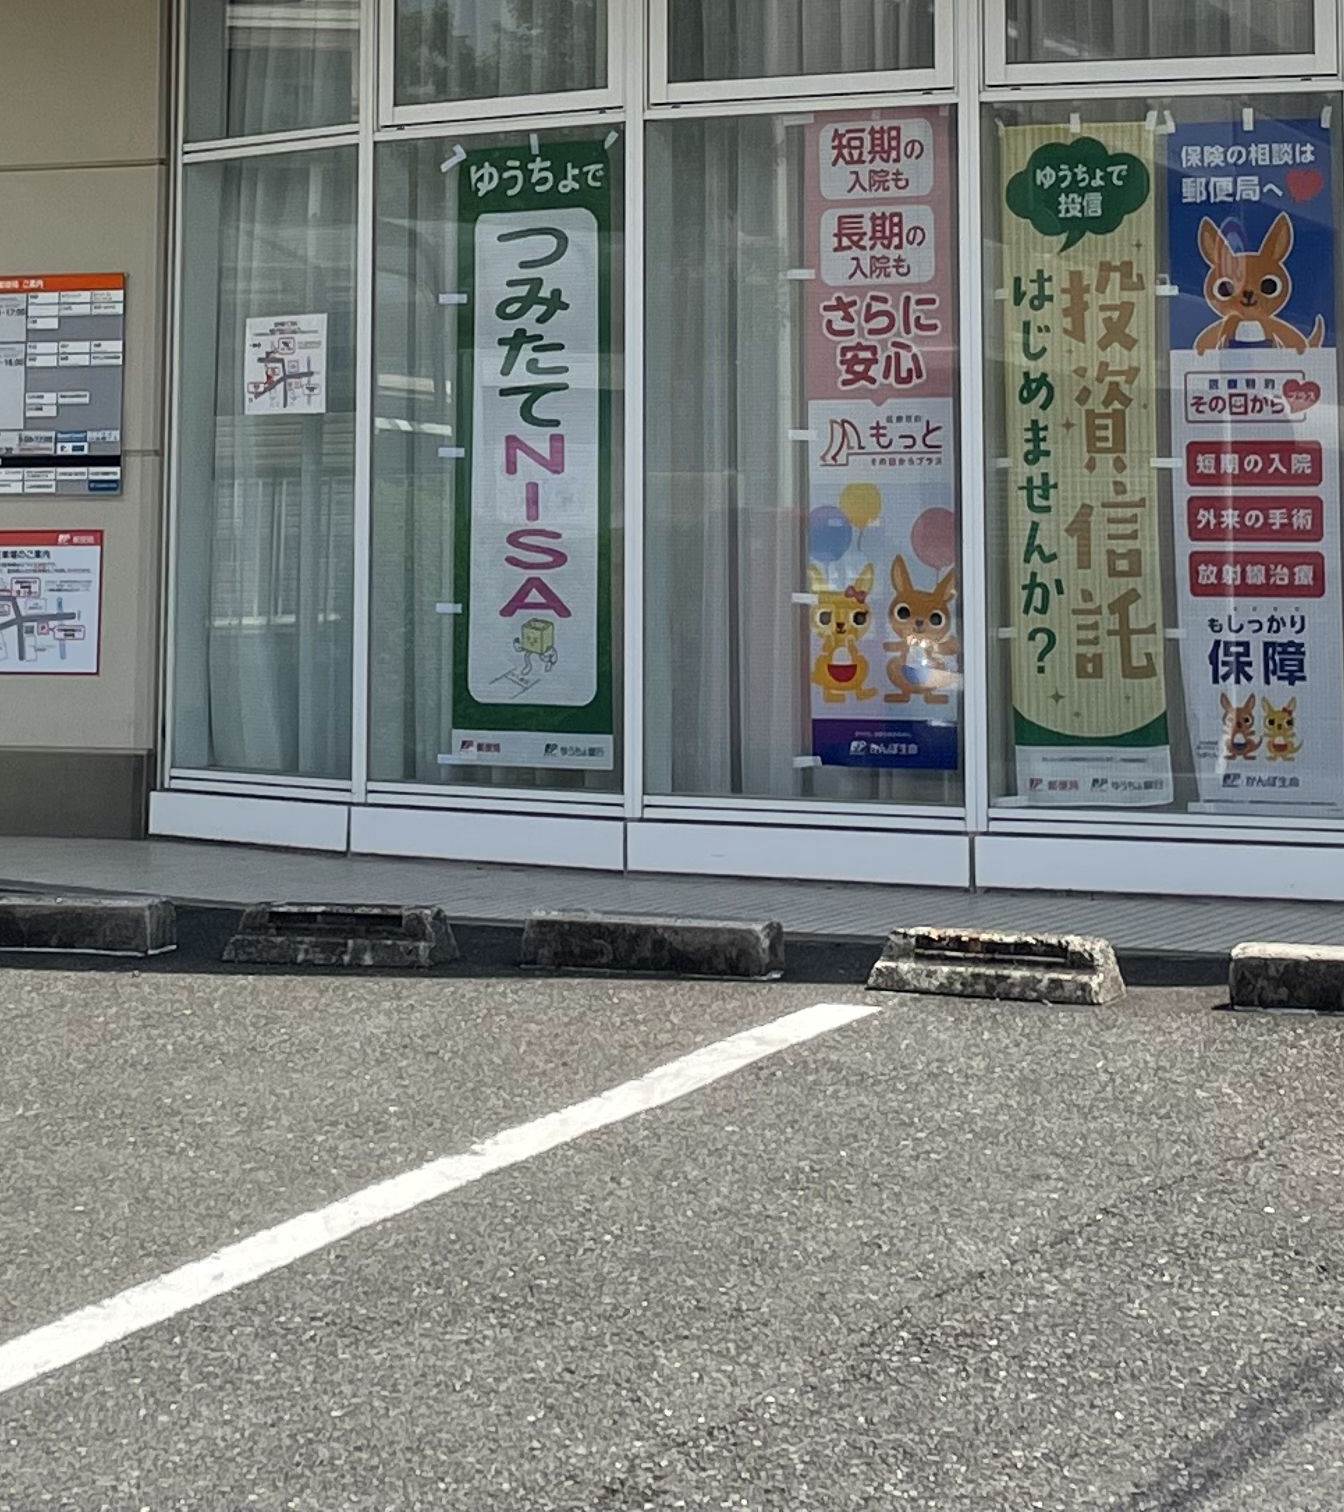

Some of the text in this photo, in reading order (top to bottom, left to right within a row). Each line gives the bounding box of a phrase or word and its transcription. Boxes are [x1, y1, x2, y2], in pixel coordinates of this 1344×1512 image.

[830, 125, 924, 167] 短期の
[1181, 142, 1316, 168] 保険の相談は
[469, 156, 605, 197] ゆうちょで
[846, 169, 910, 194] 入院も
[1035, 164, 1129, 190] ゆうちょで
[1181, 175, 1284, 204] 郵便局へ
[1058, 191, 1104, 219] 投信
[832, 211, 926, 253] 長期の
[848, 255, 911, 280] 入院も
[822, 294, 939, 337] さらに
[839, 341, 924, 386] 安心
[494, 225, 573, 619] つみたてNISA
[869, 419, 944, 449] もっと
[1059, 259, 1158, 681] 投資信託
[1195, 453, 1313, 474] 短期の入院
[1196, 508, 1313, 530] 外来の手術
[1197, 563, 1315, 586] 放射線治療
[1207, 614, 1307, 635] もしっかり
[1207, 638, 1307, 687] 保障
